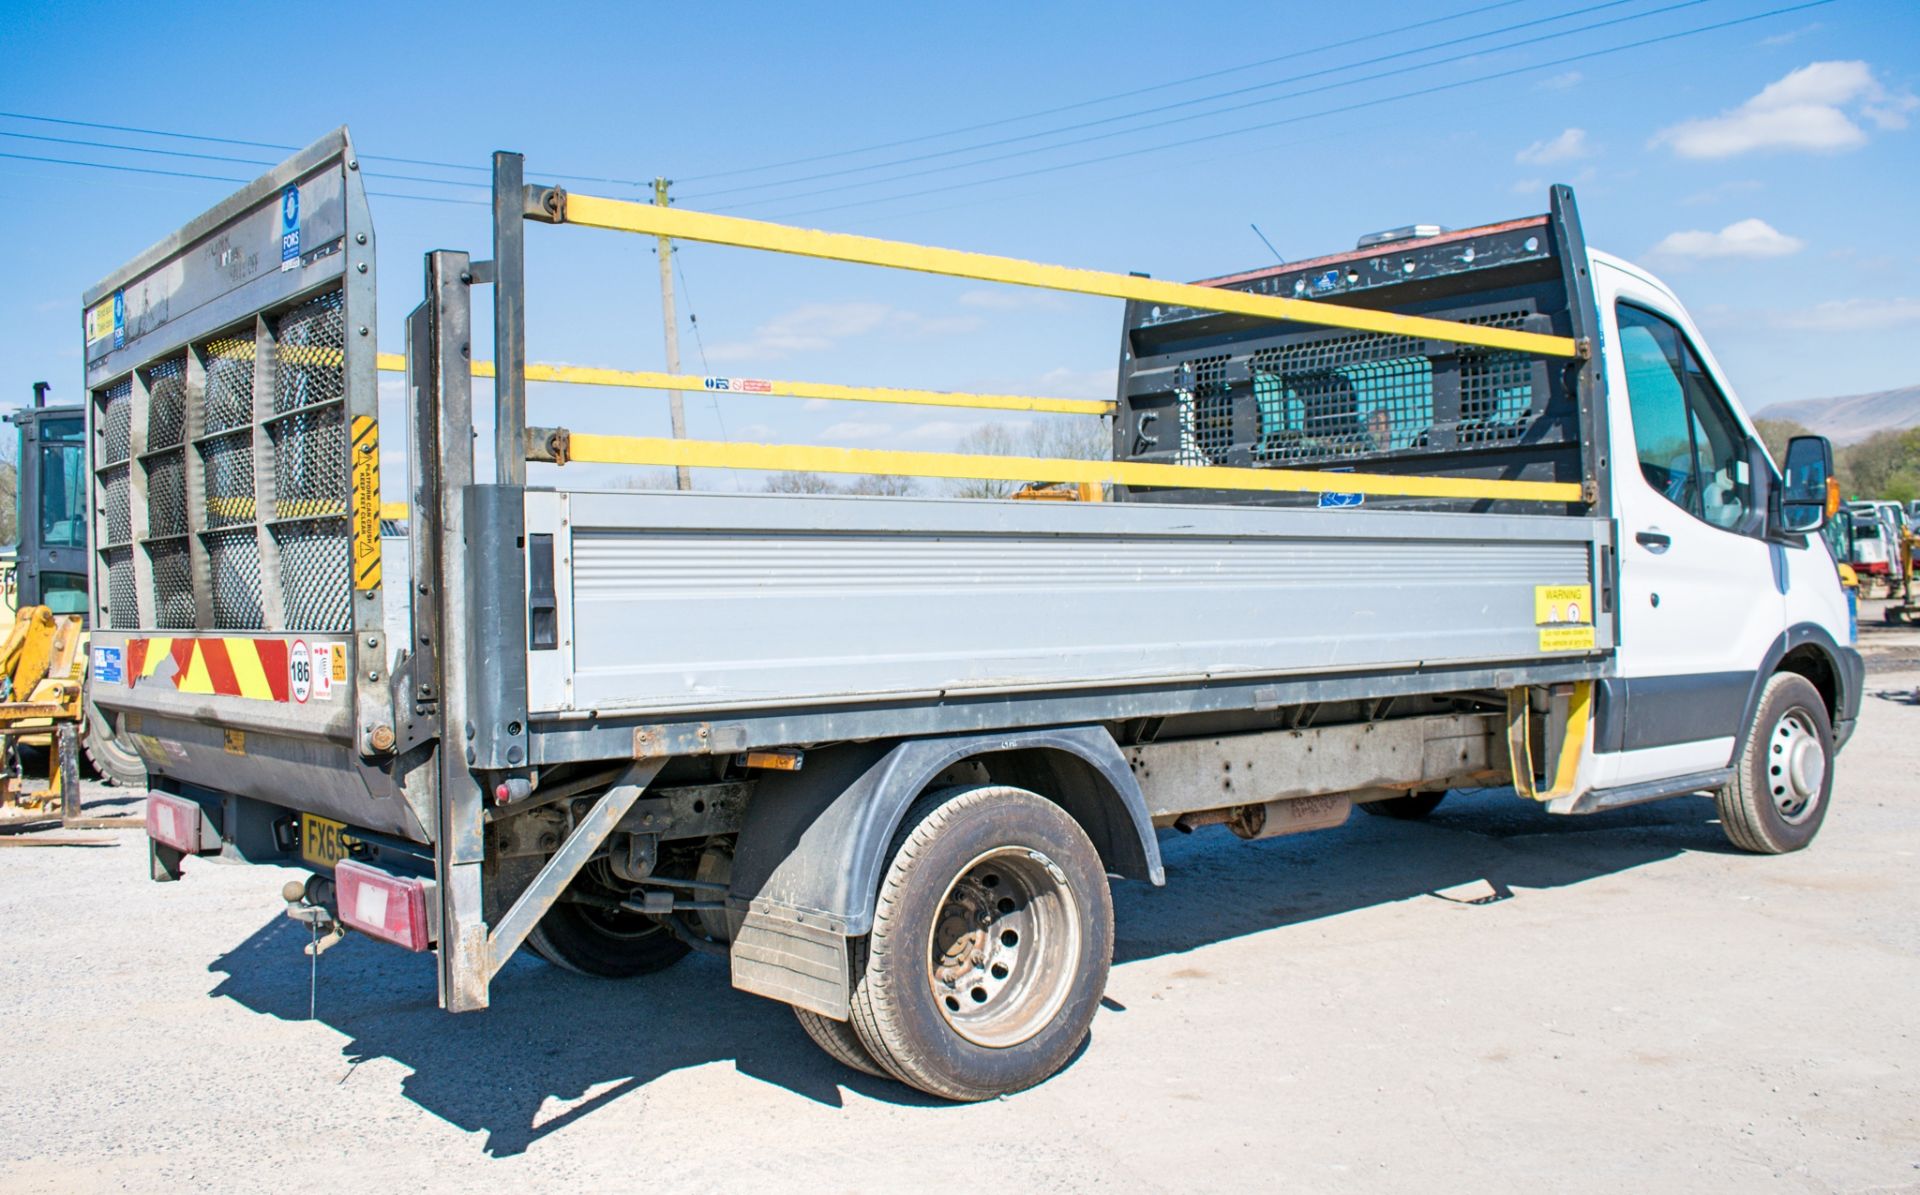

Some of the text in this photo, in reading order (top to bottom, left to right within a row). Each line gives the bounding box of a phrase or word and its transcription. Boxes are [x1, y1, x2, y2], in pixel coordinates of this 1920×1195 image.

[283, 231, 299, 250] FORS
[1545, 589, 1582, 600] WARNING
[291, 661, 310, 682] 186
